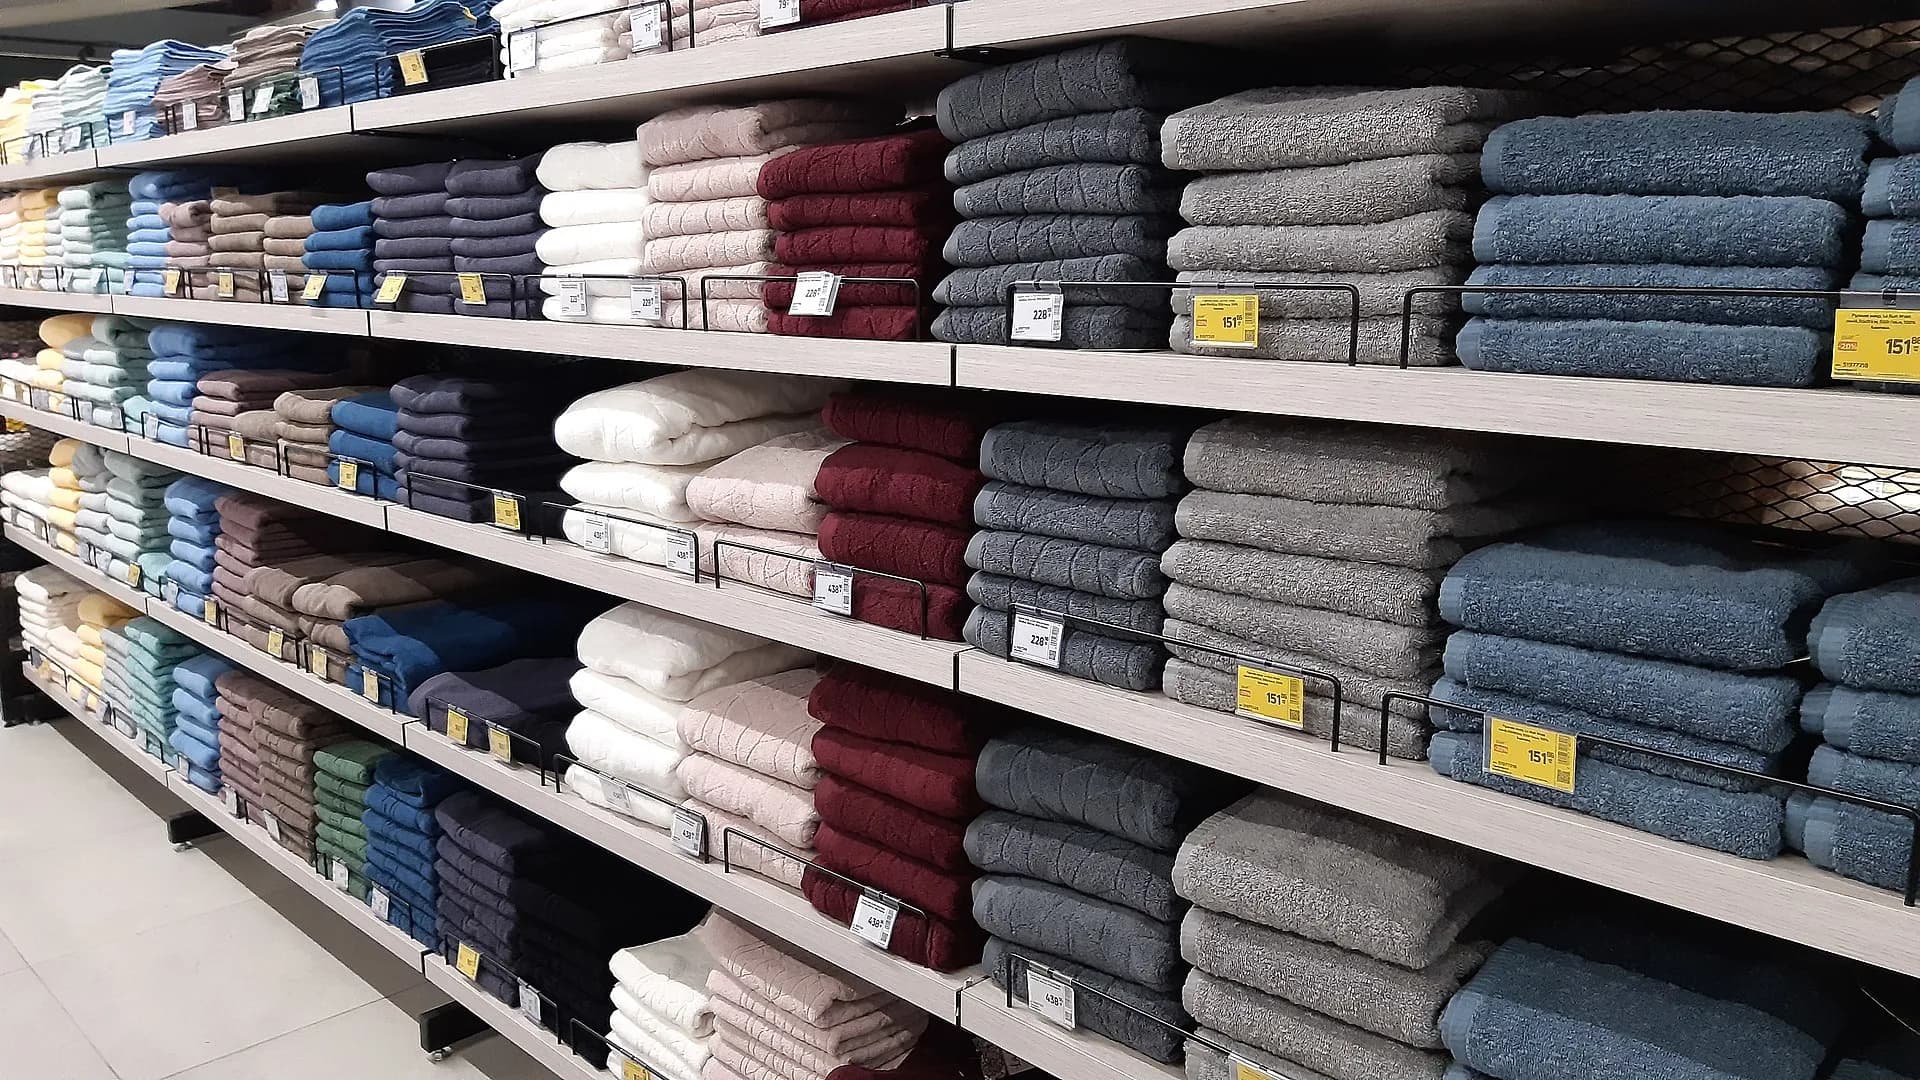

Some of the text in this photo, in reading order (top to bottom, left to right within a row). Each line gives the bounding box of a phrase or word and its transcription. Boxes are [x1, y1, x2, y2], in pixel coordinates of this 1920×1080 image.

[1033, 309, 1048, 320] 228
[1222, 316, 1237, 328] 151
[1886, 338, 1911, 355] 151
[1030, 634, 1045, 647] 228
[1266, 692, 1281, 706] 151
[1528, 749, 1547, 765] 151
[1045, 993, 1059, 1006] 438
